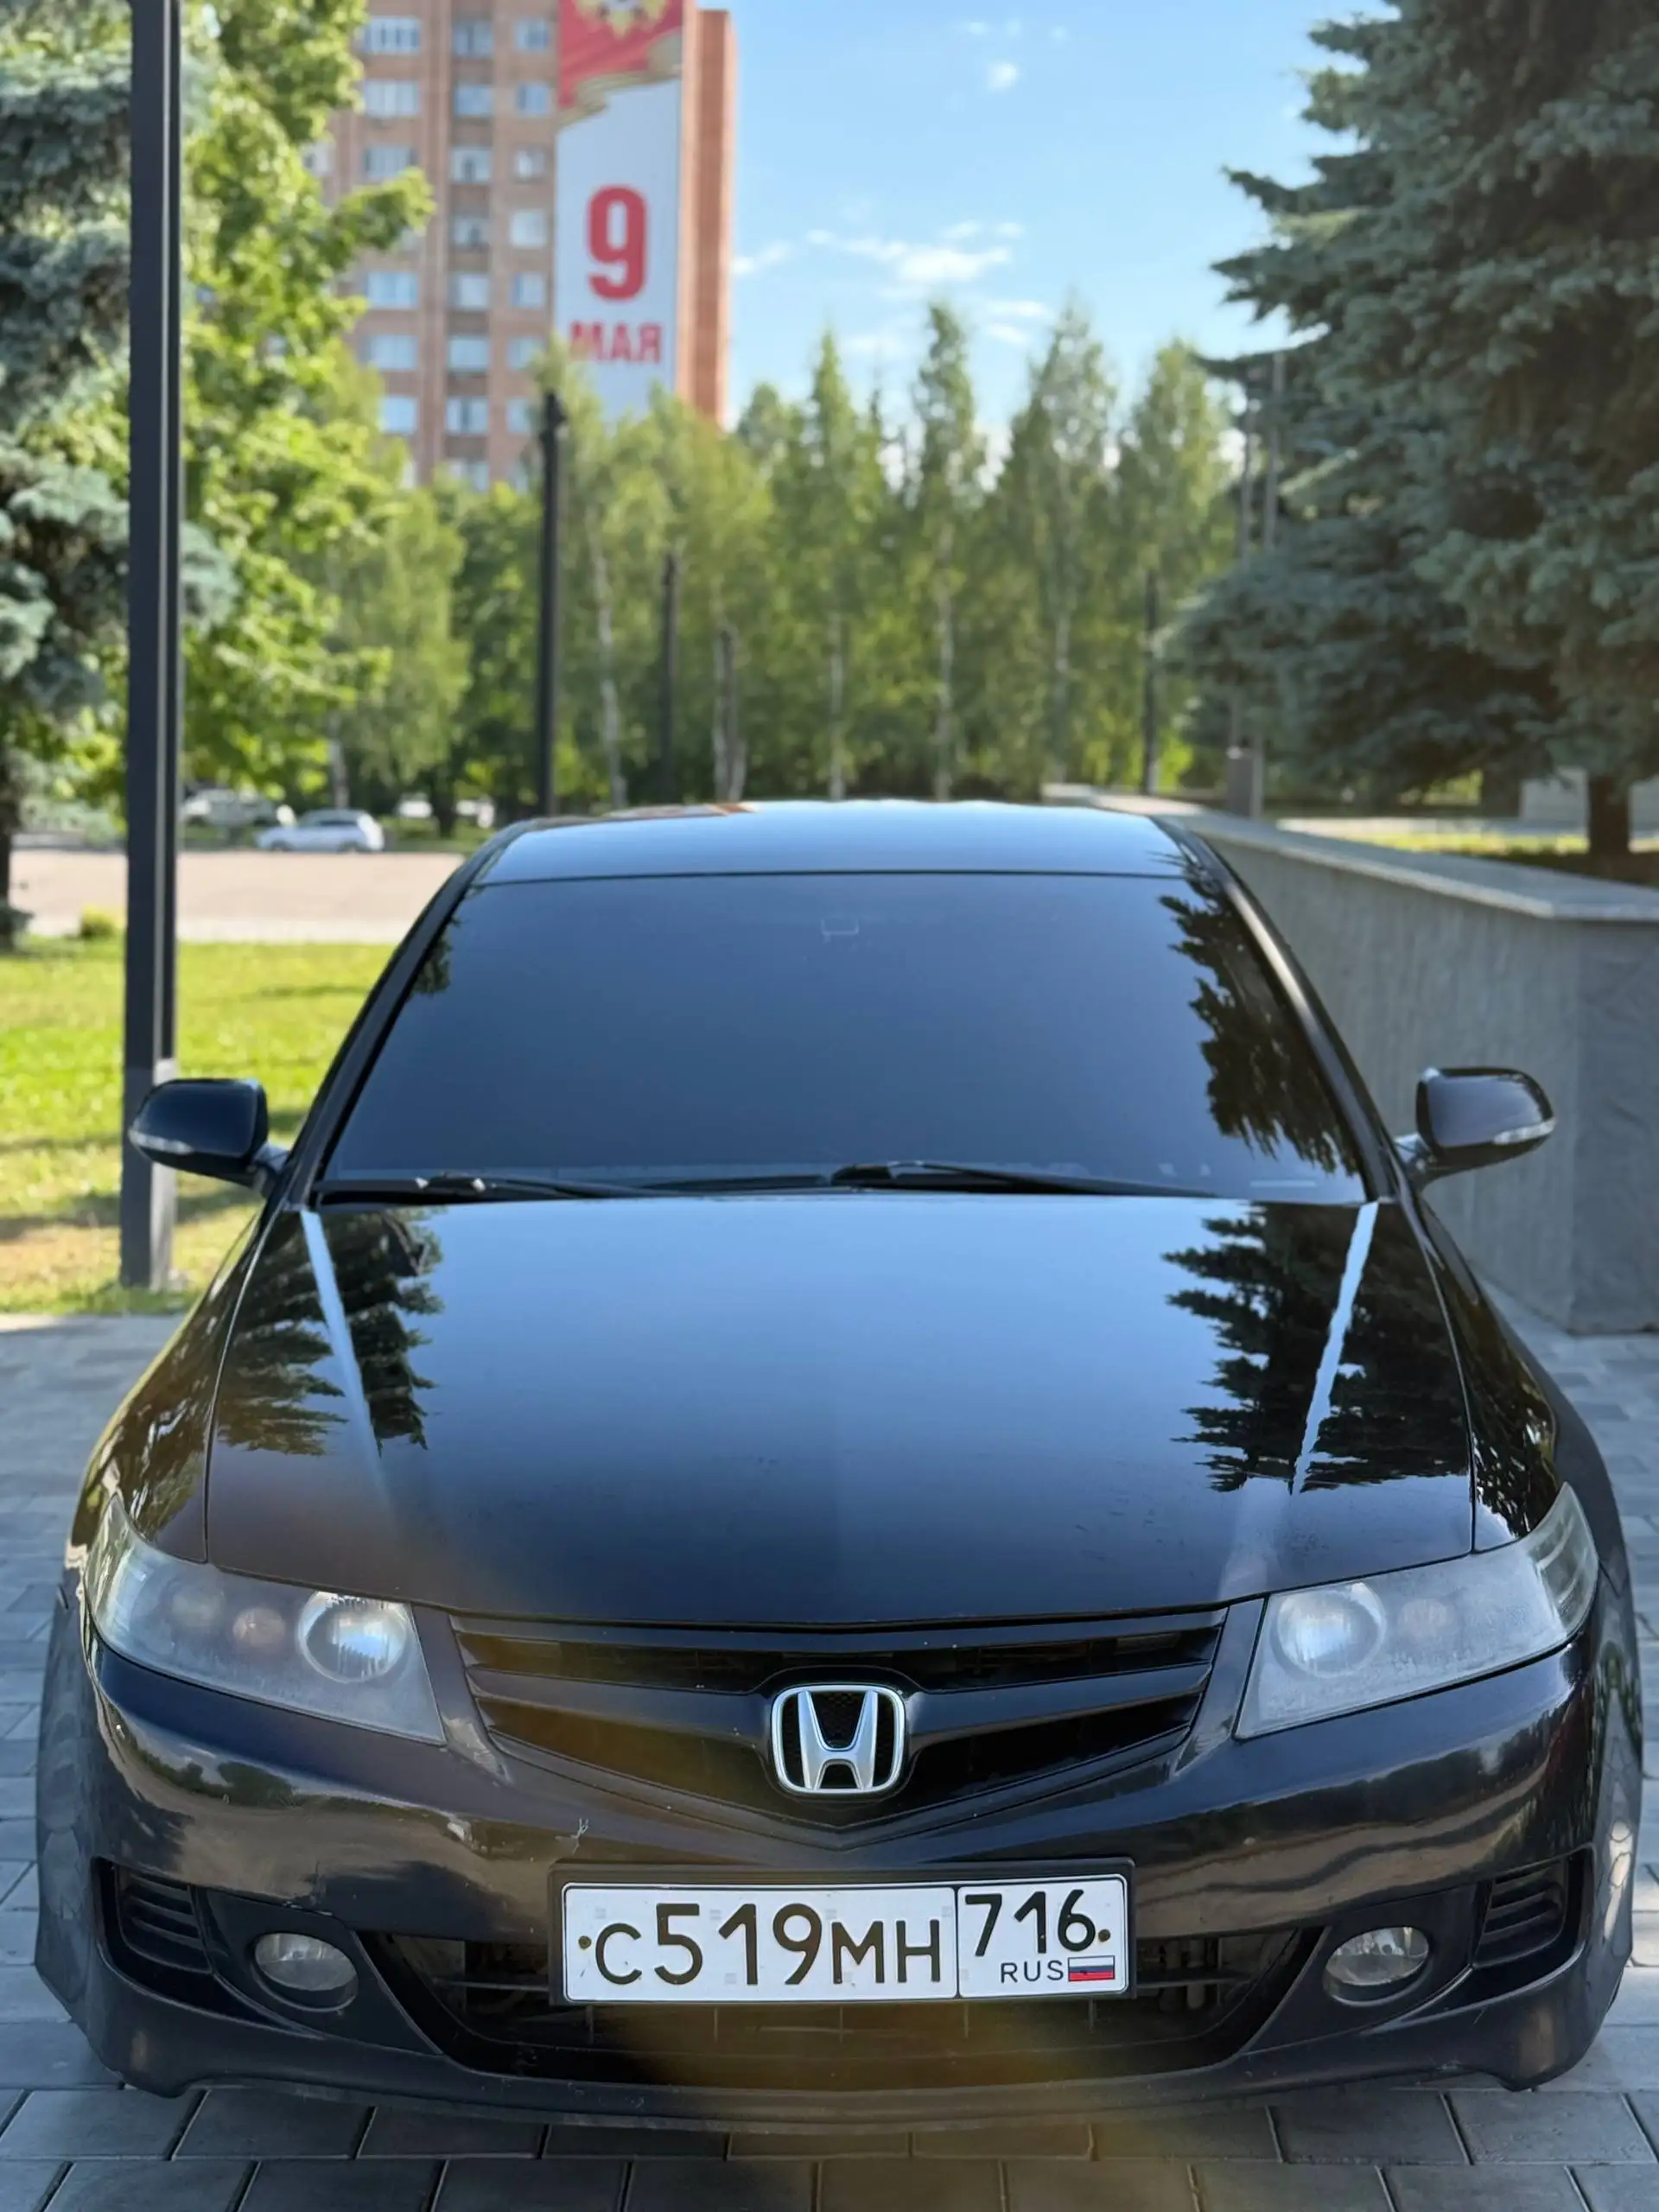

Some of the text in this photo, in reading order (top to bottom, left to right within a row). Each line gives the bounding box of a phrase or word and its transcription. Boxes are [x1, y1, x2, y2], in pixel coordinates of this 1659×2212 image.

[588, 185, 647, 301] 9
[570, 321, 662, 364] МАЯ
[594, 1889, 1096, 1986] С519МН 716
[1000, 1959, 1064, 1983] RUS
